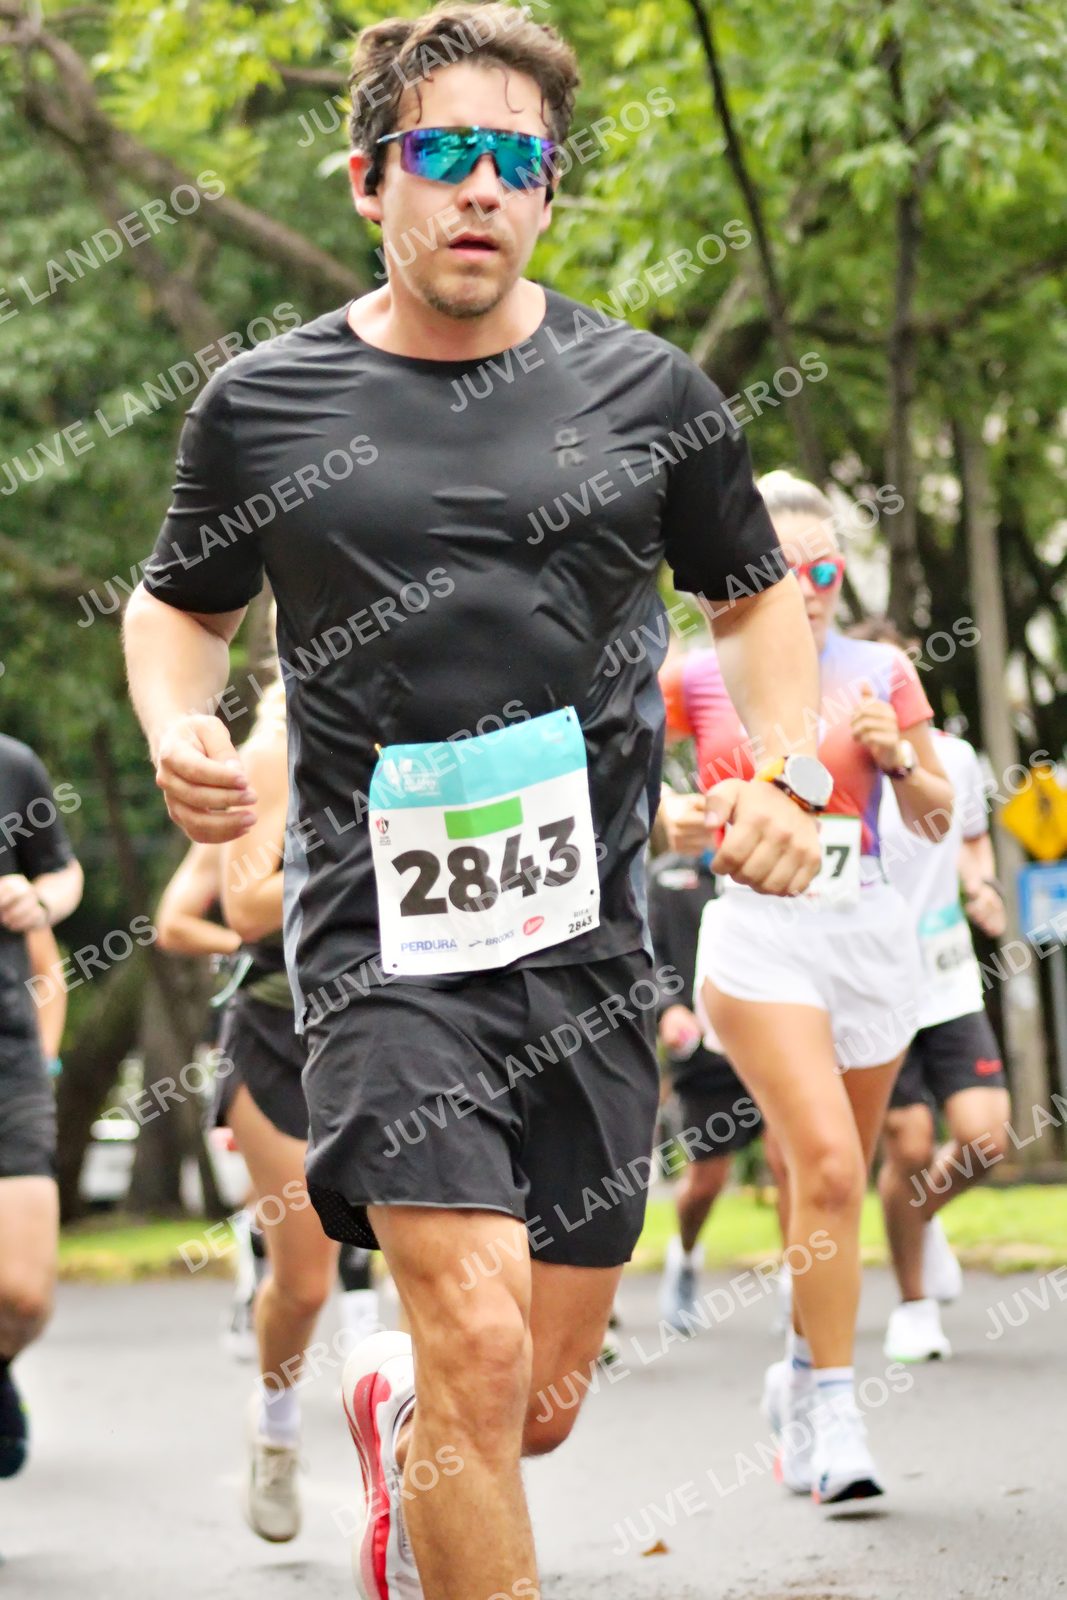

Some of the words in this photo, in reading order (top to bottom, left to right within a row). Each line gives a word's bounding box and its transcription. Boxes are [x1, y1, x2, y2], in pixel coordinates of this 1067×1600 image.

[391, 816, 582, 917] 2843
[567, 915, 593, 934] 2843
[400, 938, 458, 953] PERDURA
